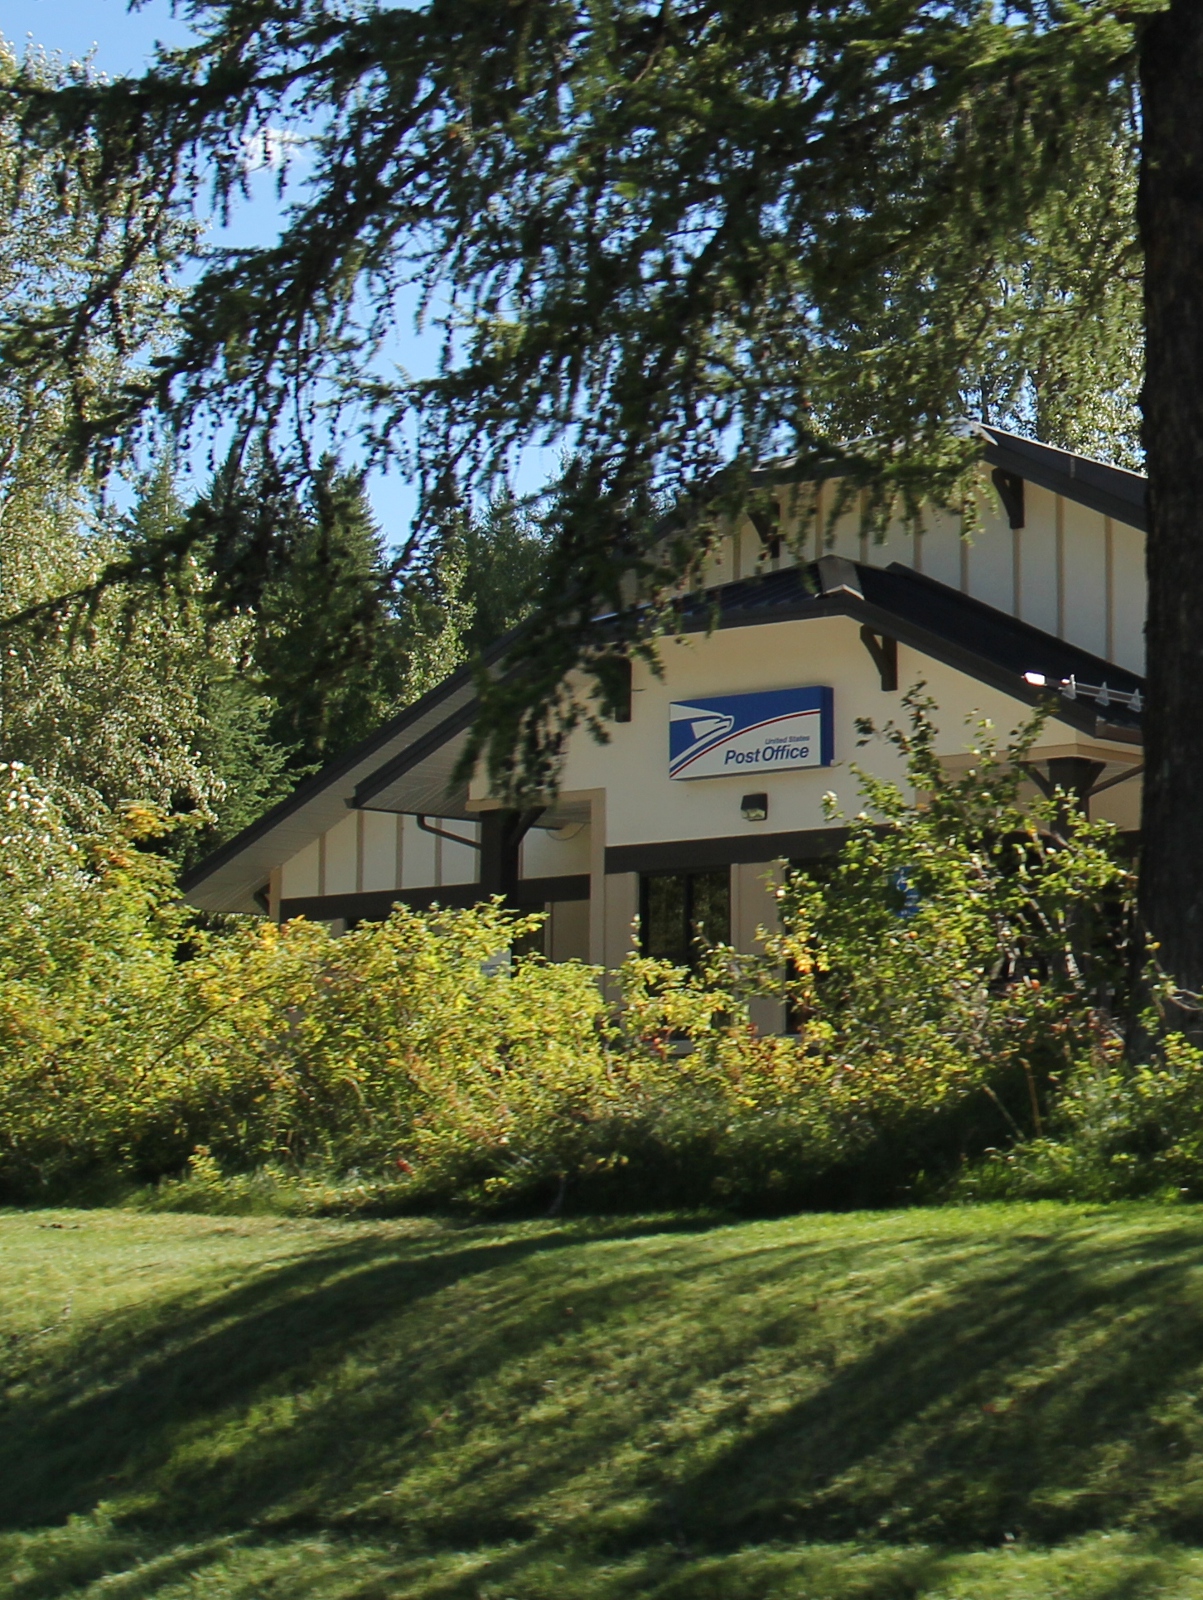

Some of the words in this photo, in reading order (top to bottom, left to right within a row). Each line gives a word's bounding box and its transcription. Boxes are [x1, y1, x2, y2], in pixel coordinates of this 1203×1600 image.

[765, 736, 788, 745] United
[788, 735, 810, 743] States
[724, 748, 761, 765] Post
[762, 744, 810, 762] Office
